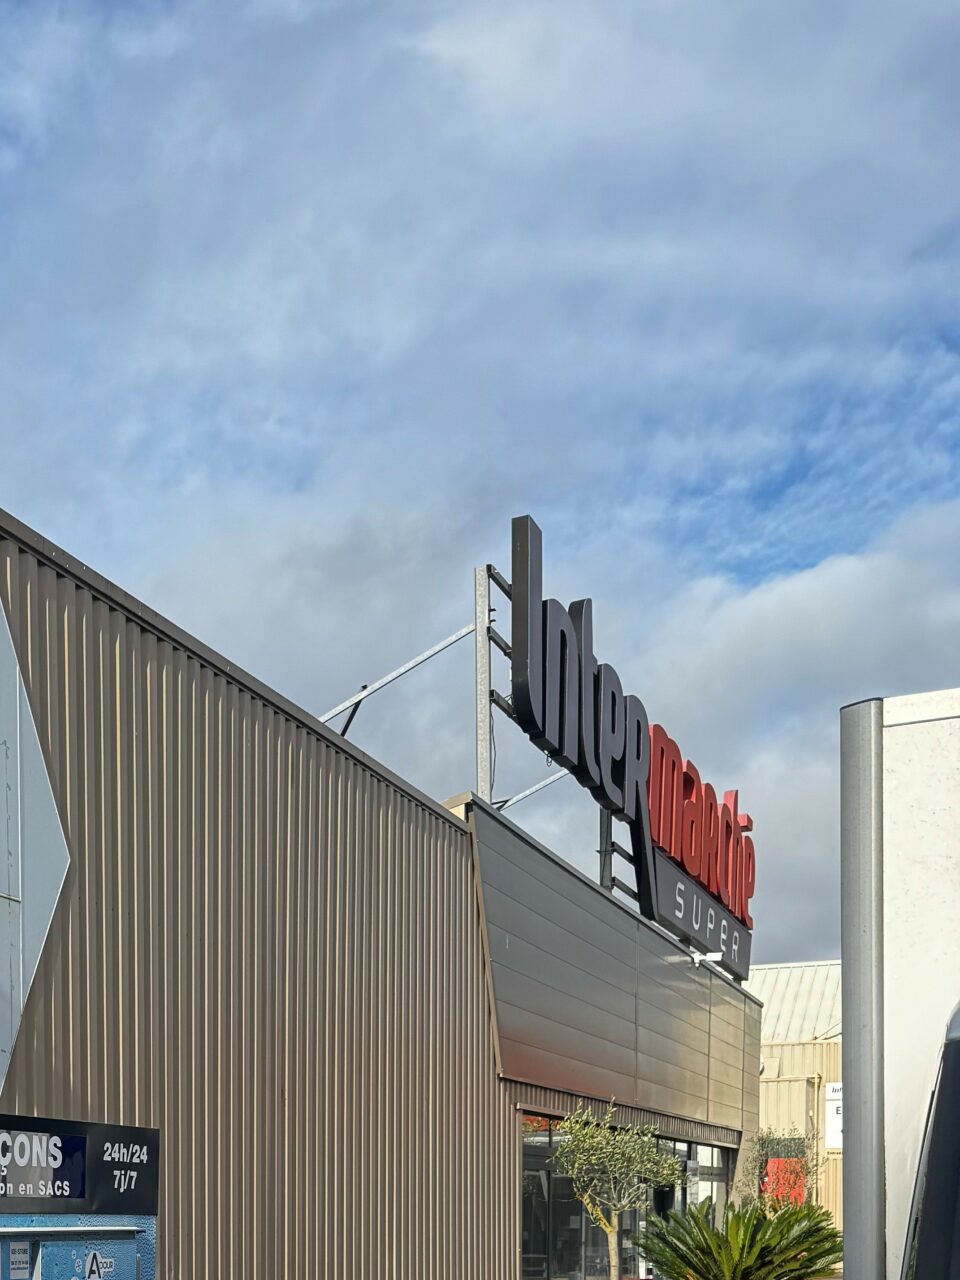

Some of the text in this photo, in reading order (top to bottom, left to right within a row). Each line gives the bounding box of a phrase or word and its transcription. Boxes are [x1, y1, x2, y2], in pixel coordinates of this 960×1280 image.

[103, 1142, 148, 1164] 24h/24
[19, 1183, 33, 1194] en
[39, 1180, 70, 1196] SACS
[113, 1170, 137, 1193] 7j/7
